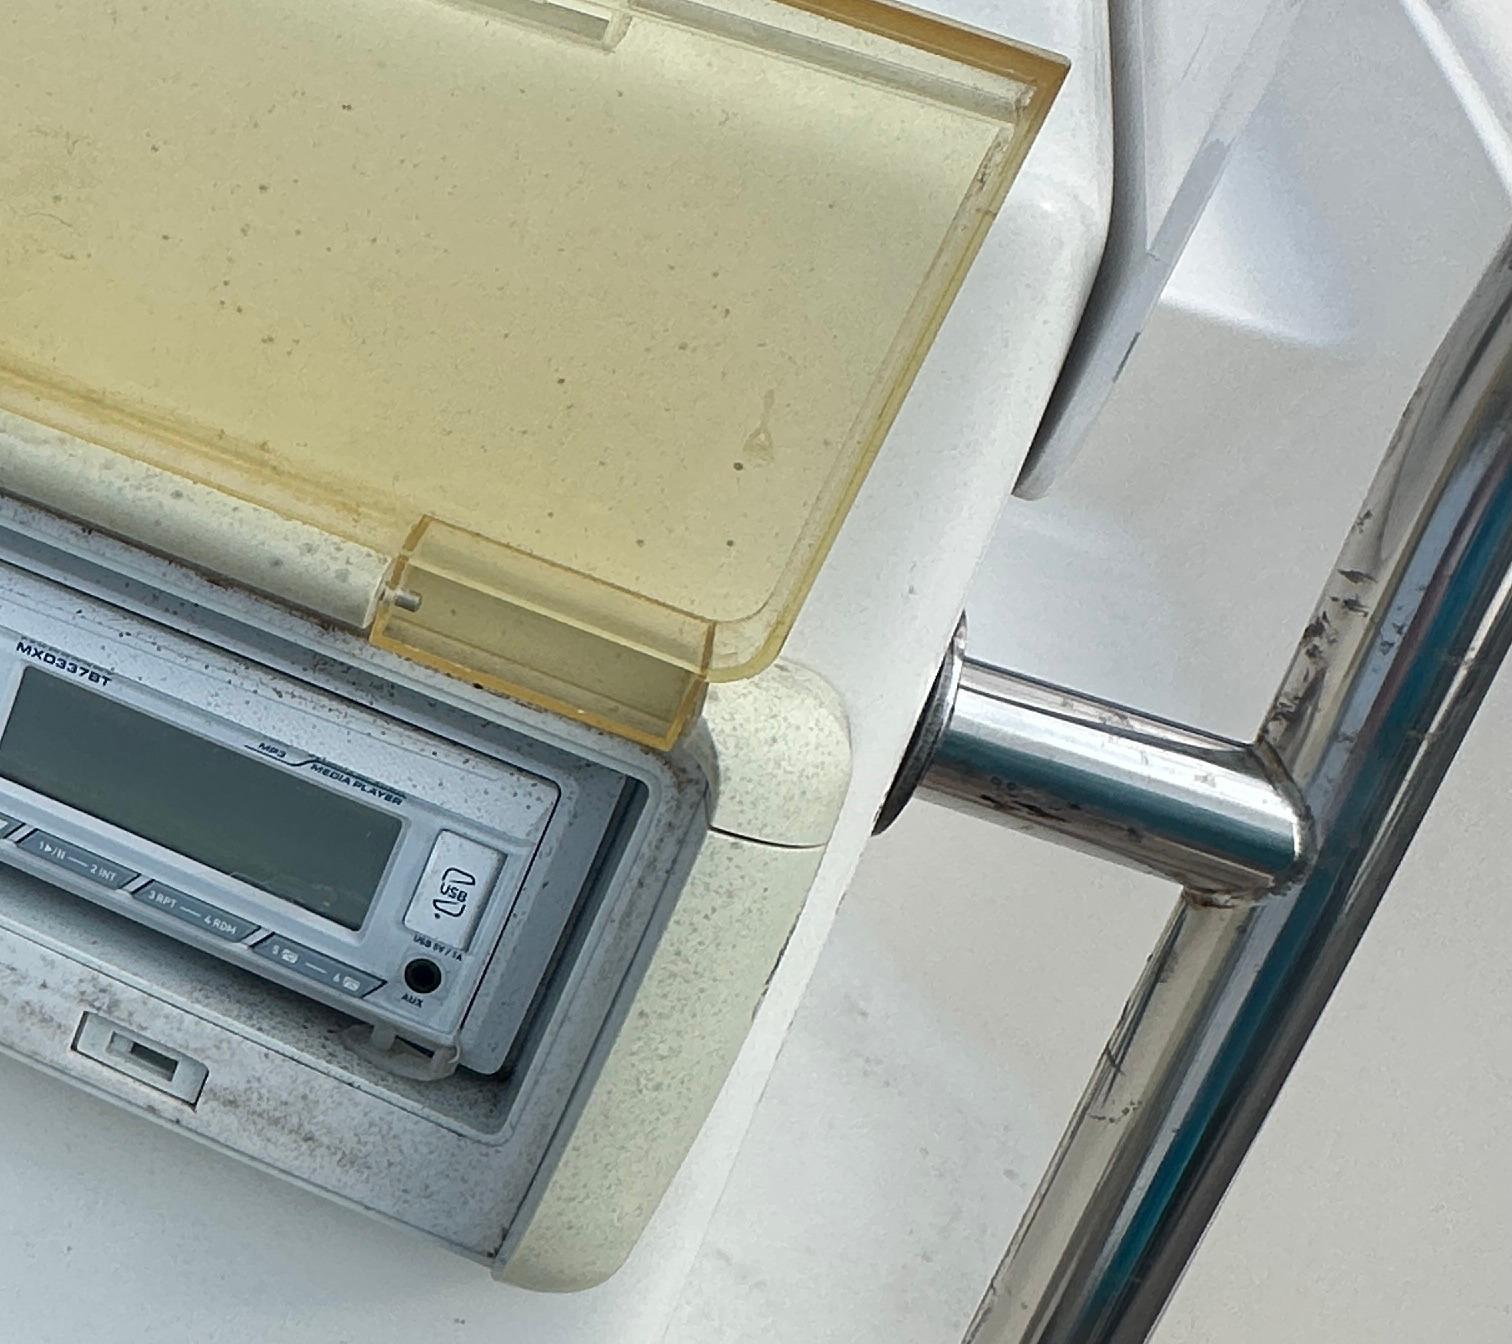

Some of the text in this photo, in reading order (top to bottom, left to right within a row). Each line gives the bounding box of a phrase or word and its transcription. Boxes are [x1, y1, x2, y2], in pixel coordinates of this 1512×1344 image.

[258, 742, 287, 759] MP3
[310, 763, 403, 806] MEDIA PLAYER
[440, 882, 468, 903] USB
[401, 993, 424, 1008] AUX
